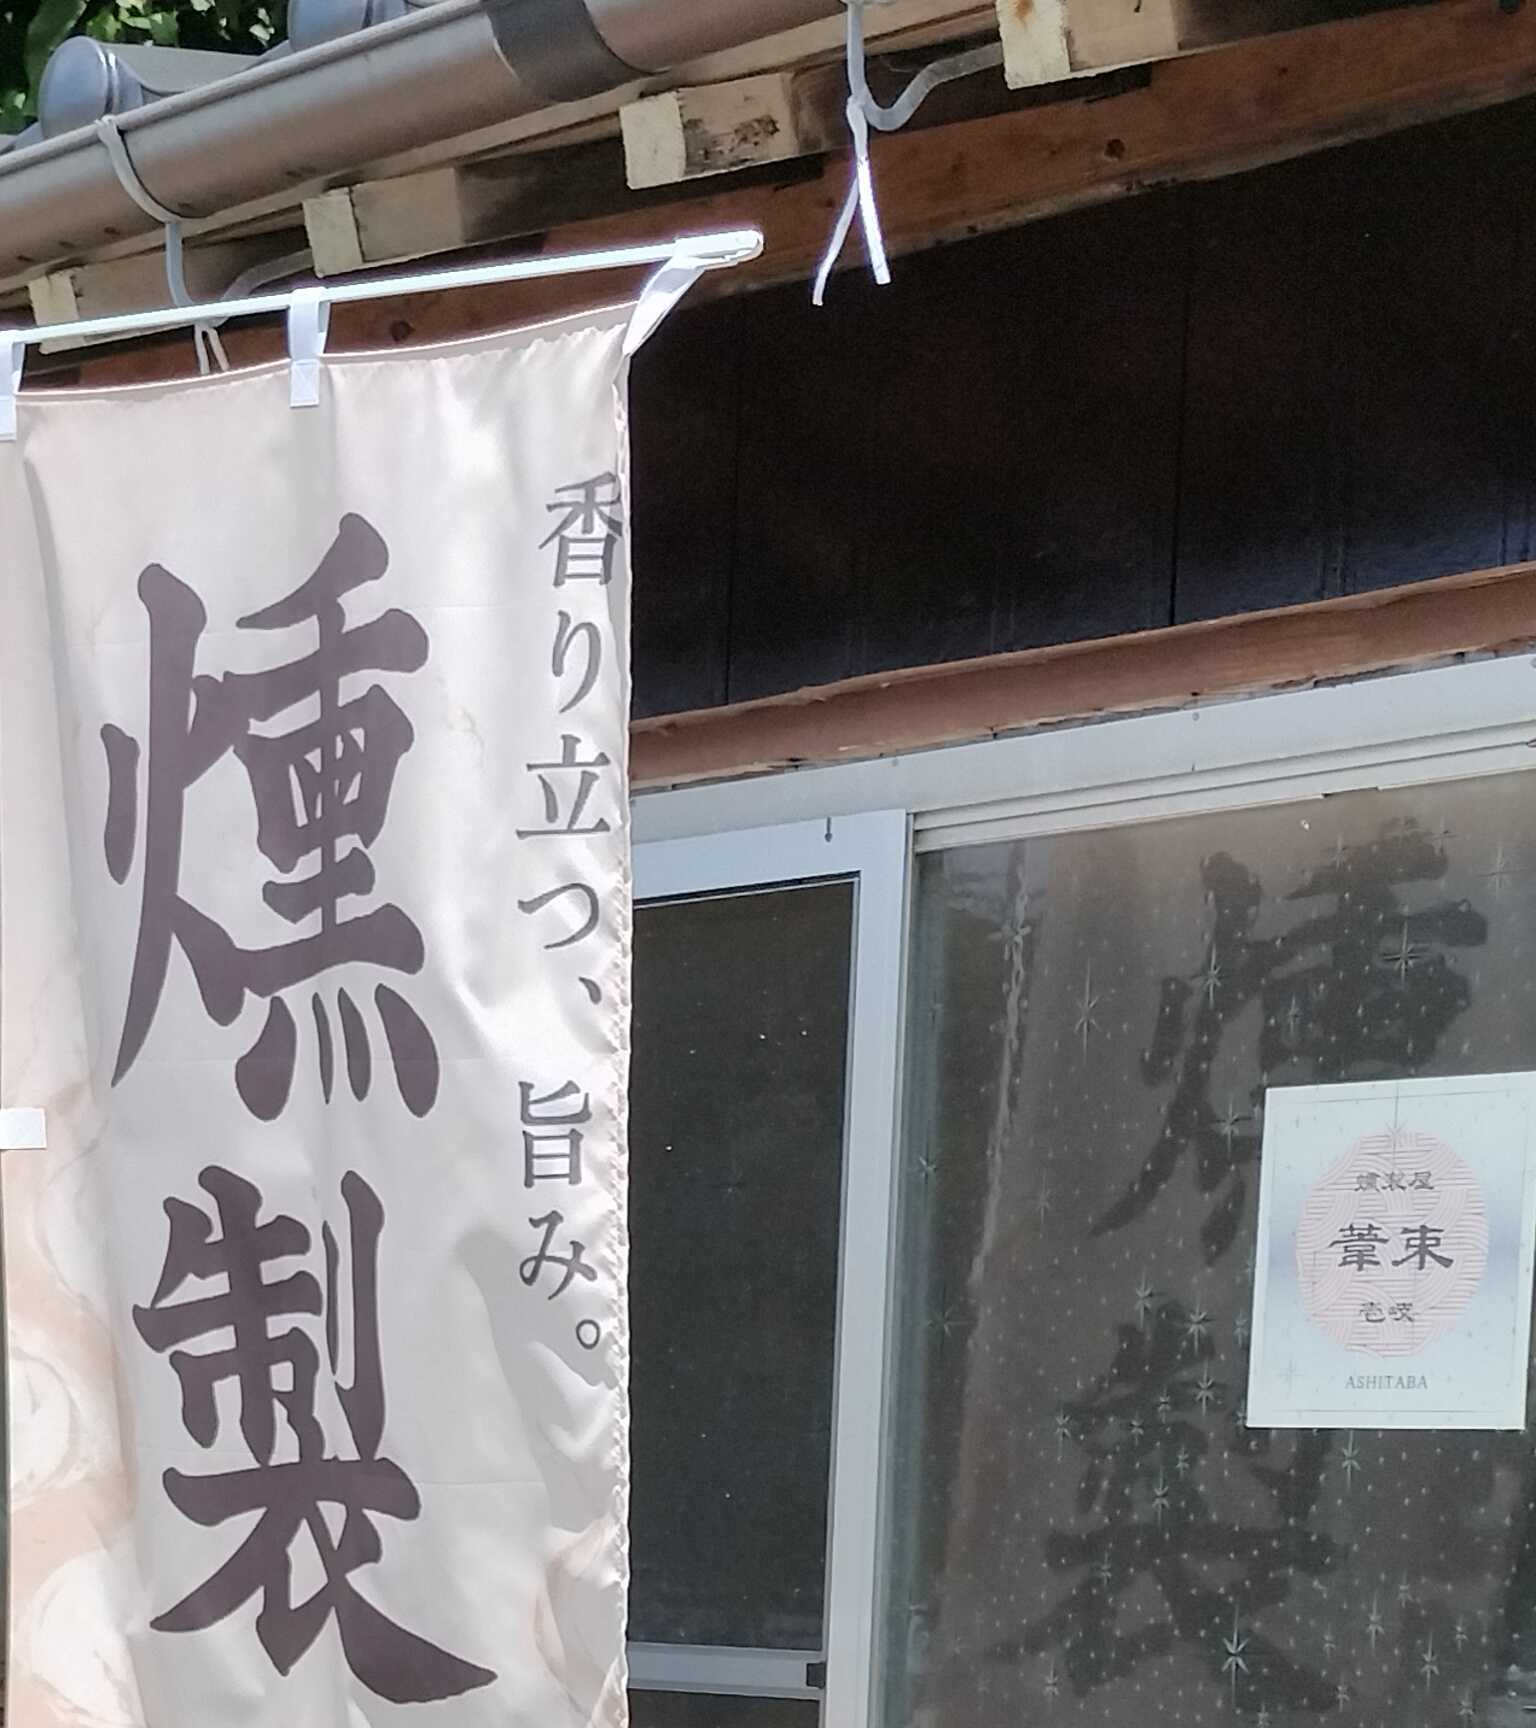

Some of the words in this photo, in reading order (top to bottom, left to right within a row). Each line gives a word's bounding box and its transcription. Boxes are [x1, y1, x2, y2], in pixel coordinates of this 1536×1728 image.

[516, 471, 623, 1350] 香り立つ、旨み。
[100, 511, 498, 1704] 燻製
[1328, 1222, 1454, 1272] 葦束
[1359, 1301, 1415, 1323] 壱岐
[1344, 1374, 1429, 1390] ASHITABA
